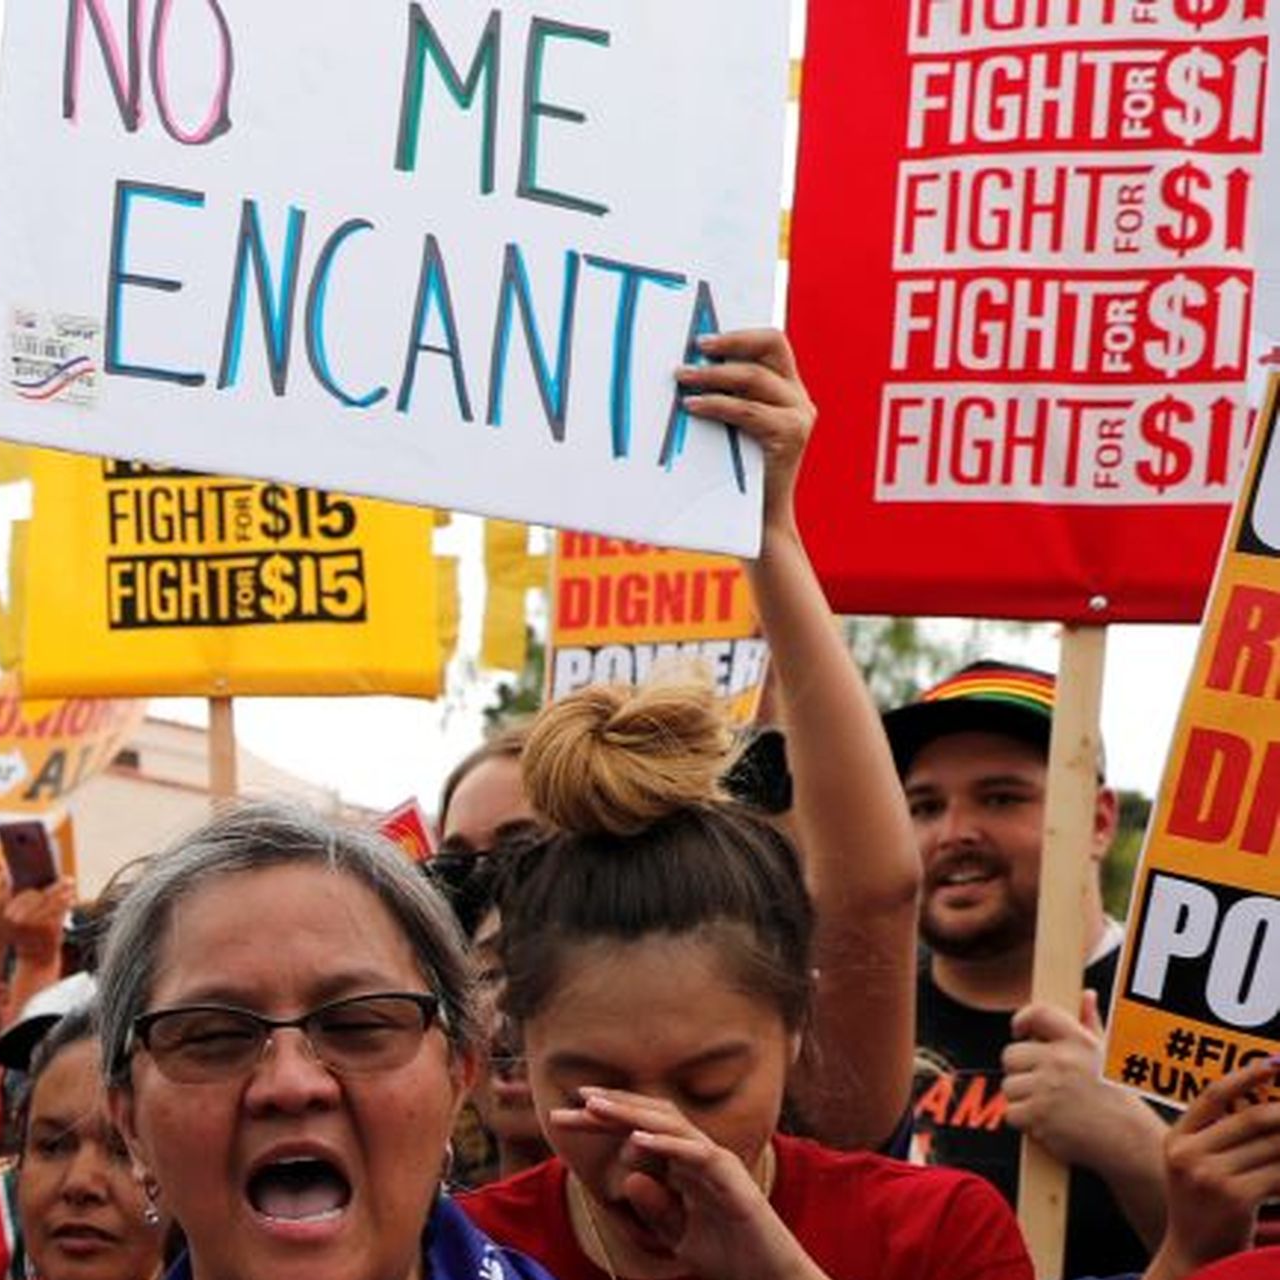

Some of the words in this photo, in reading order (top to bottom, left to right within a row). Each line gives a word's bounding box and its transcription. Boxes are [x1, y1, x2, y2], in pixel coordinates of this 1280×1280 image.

[63, 0, 232, 144] NO
[396, 2, 610, 215] ME
[907, 49, 1166, 148] FIGHT
[1120, 66, 1157, 138] FOR
[1162, 46, 1268, 145] $1
[900, 165, 1154, 254] FIGHT
[1115, 180, 1145, 253] FOR
[1156, 161, 1252, 257] $1
[105, 179, 745, 492] ENCANTA
[891, 277, 1149, 371] FIGHT
[1102, 298, 1138, 373] FOR
[1143, 273, 1250, 377] $1
[882, 399, 1135, 487] FIGHT
[1093, 418, 1125, 490] FOR
[1134, 393, 1235, 493] $1
[109, 485, 254, 544] FIGHT
[235, 496, 252, 541] FOR
[260, 482, 356, 541] $15
[110, 558, 258, 622] FIGHT
[237, 570, 255, 618] FOR
[260, 553, 364, 619] $15
[558, 567, 741, 630] DIGNIT
[554, 640, 765, 697] POER
